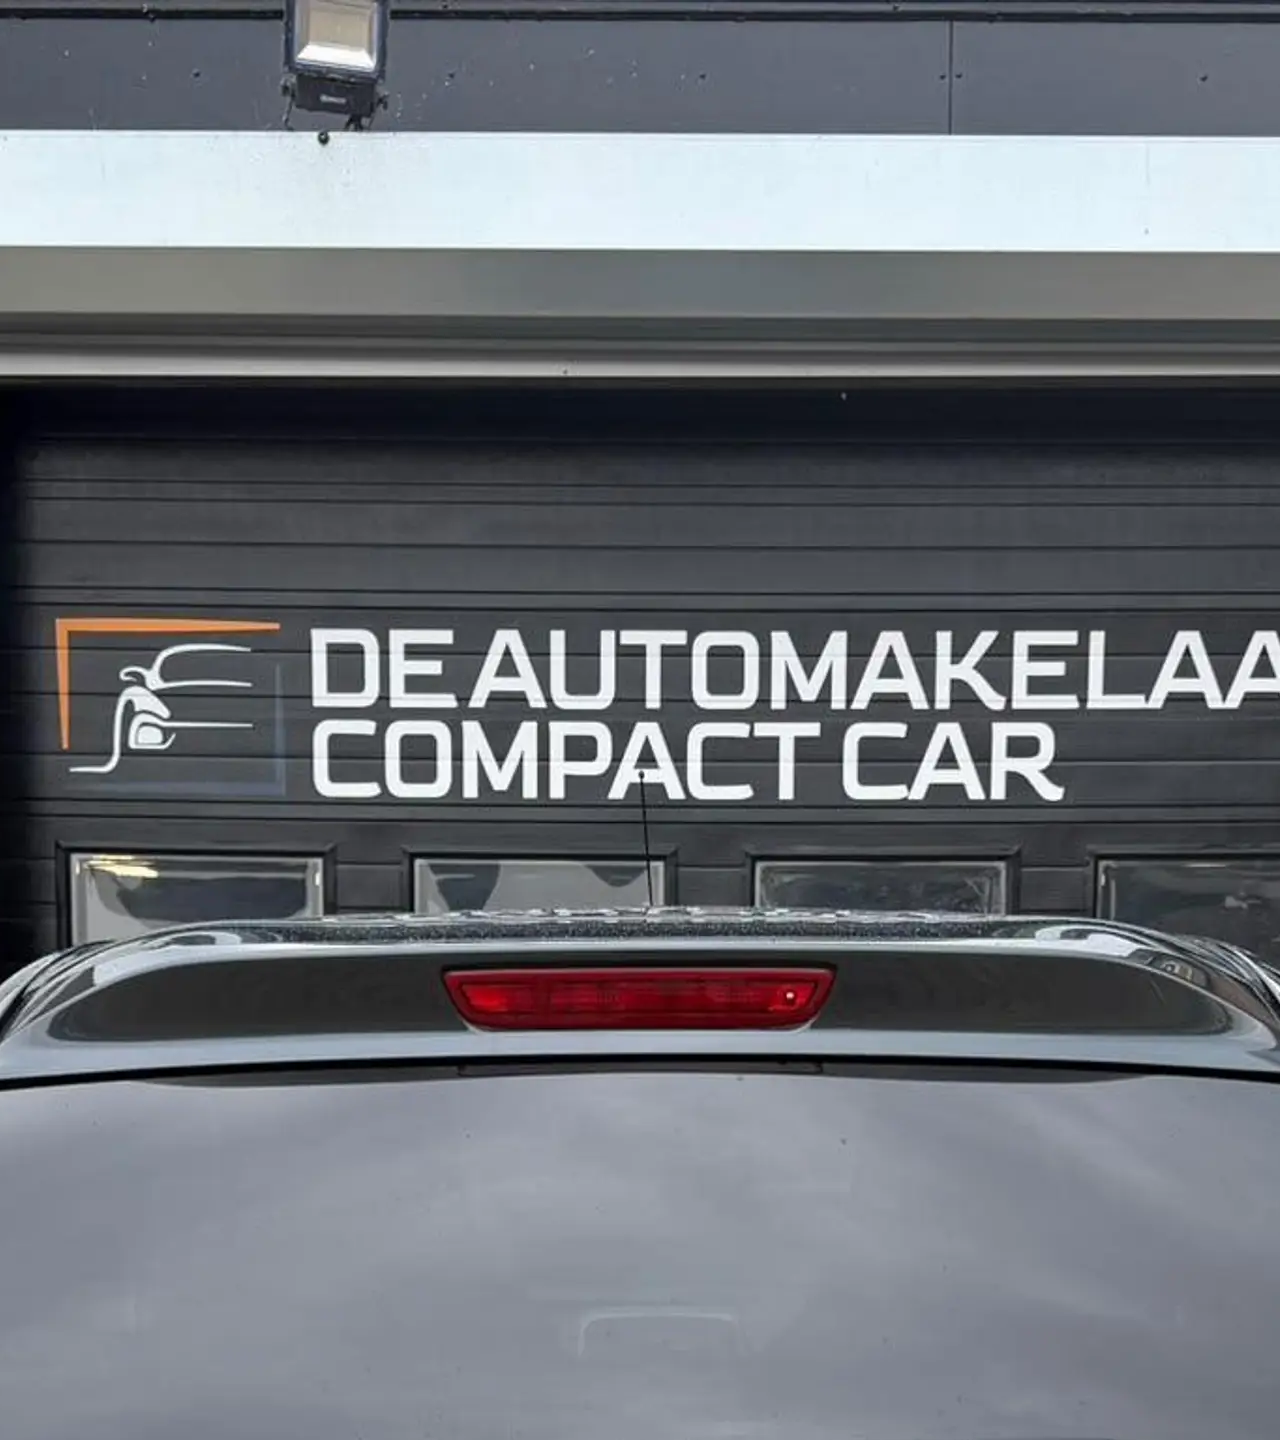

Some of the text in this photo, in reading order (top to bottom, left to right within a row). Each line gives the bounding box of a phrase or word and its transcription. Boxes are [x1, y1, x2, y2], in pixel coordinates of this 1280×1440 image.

[311, 627, 458, 709] DE
[311, 720, 1065, 802] COMPACT CAR
